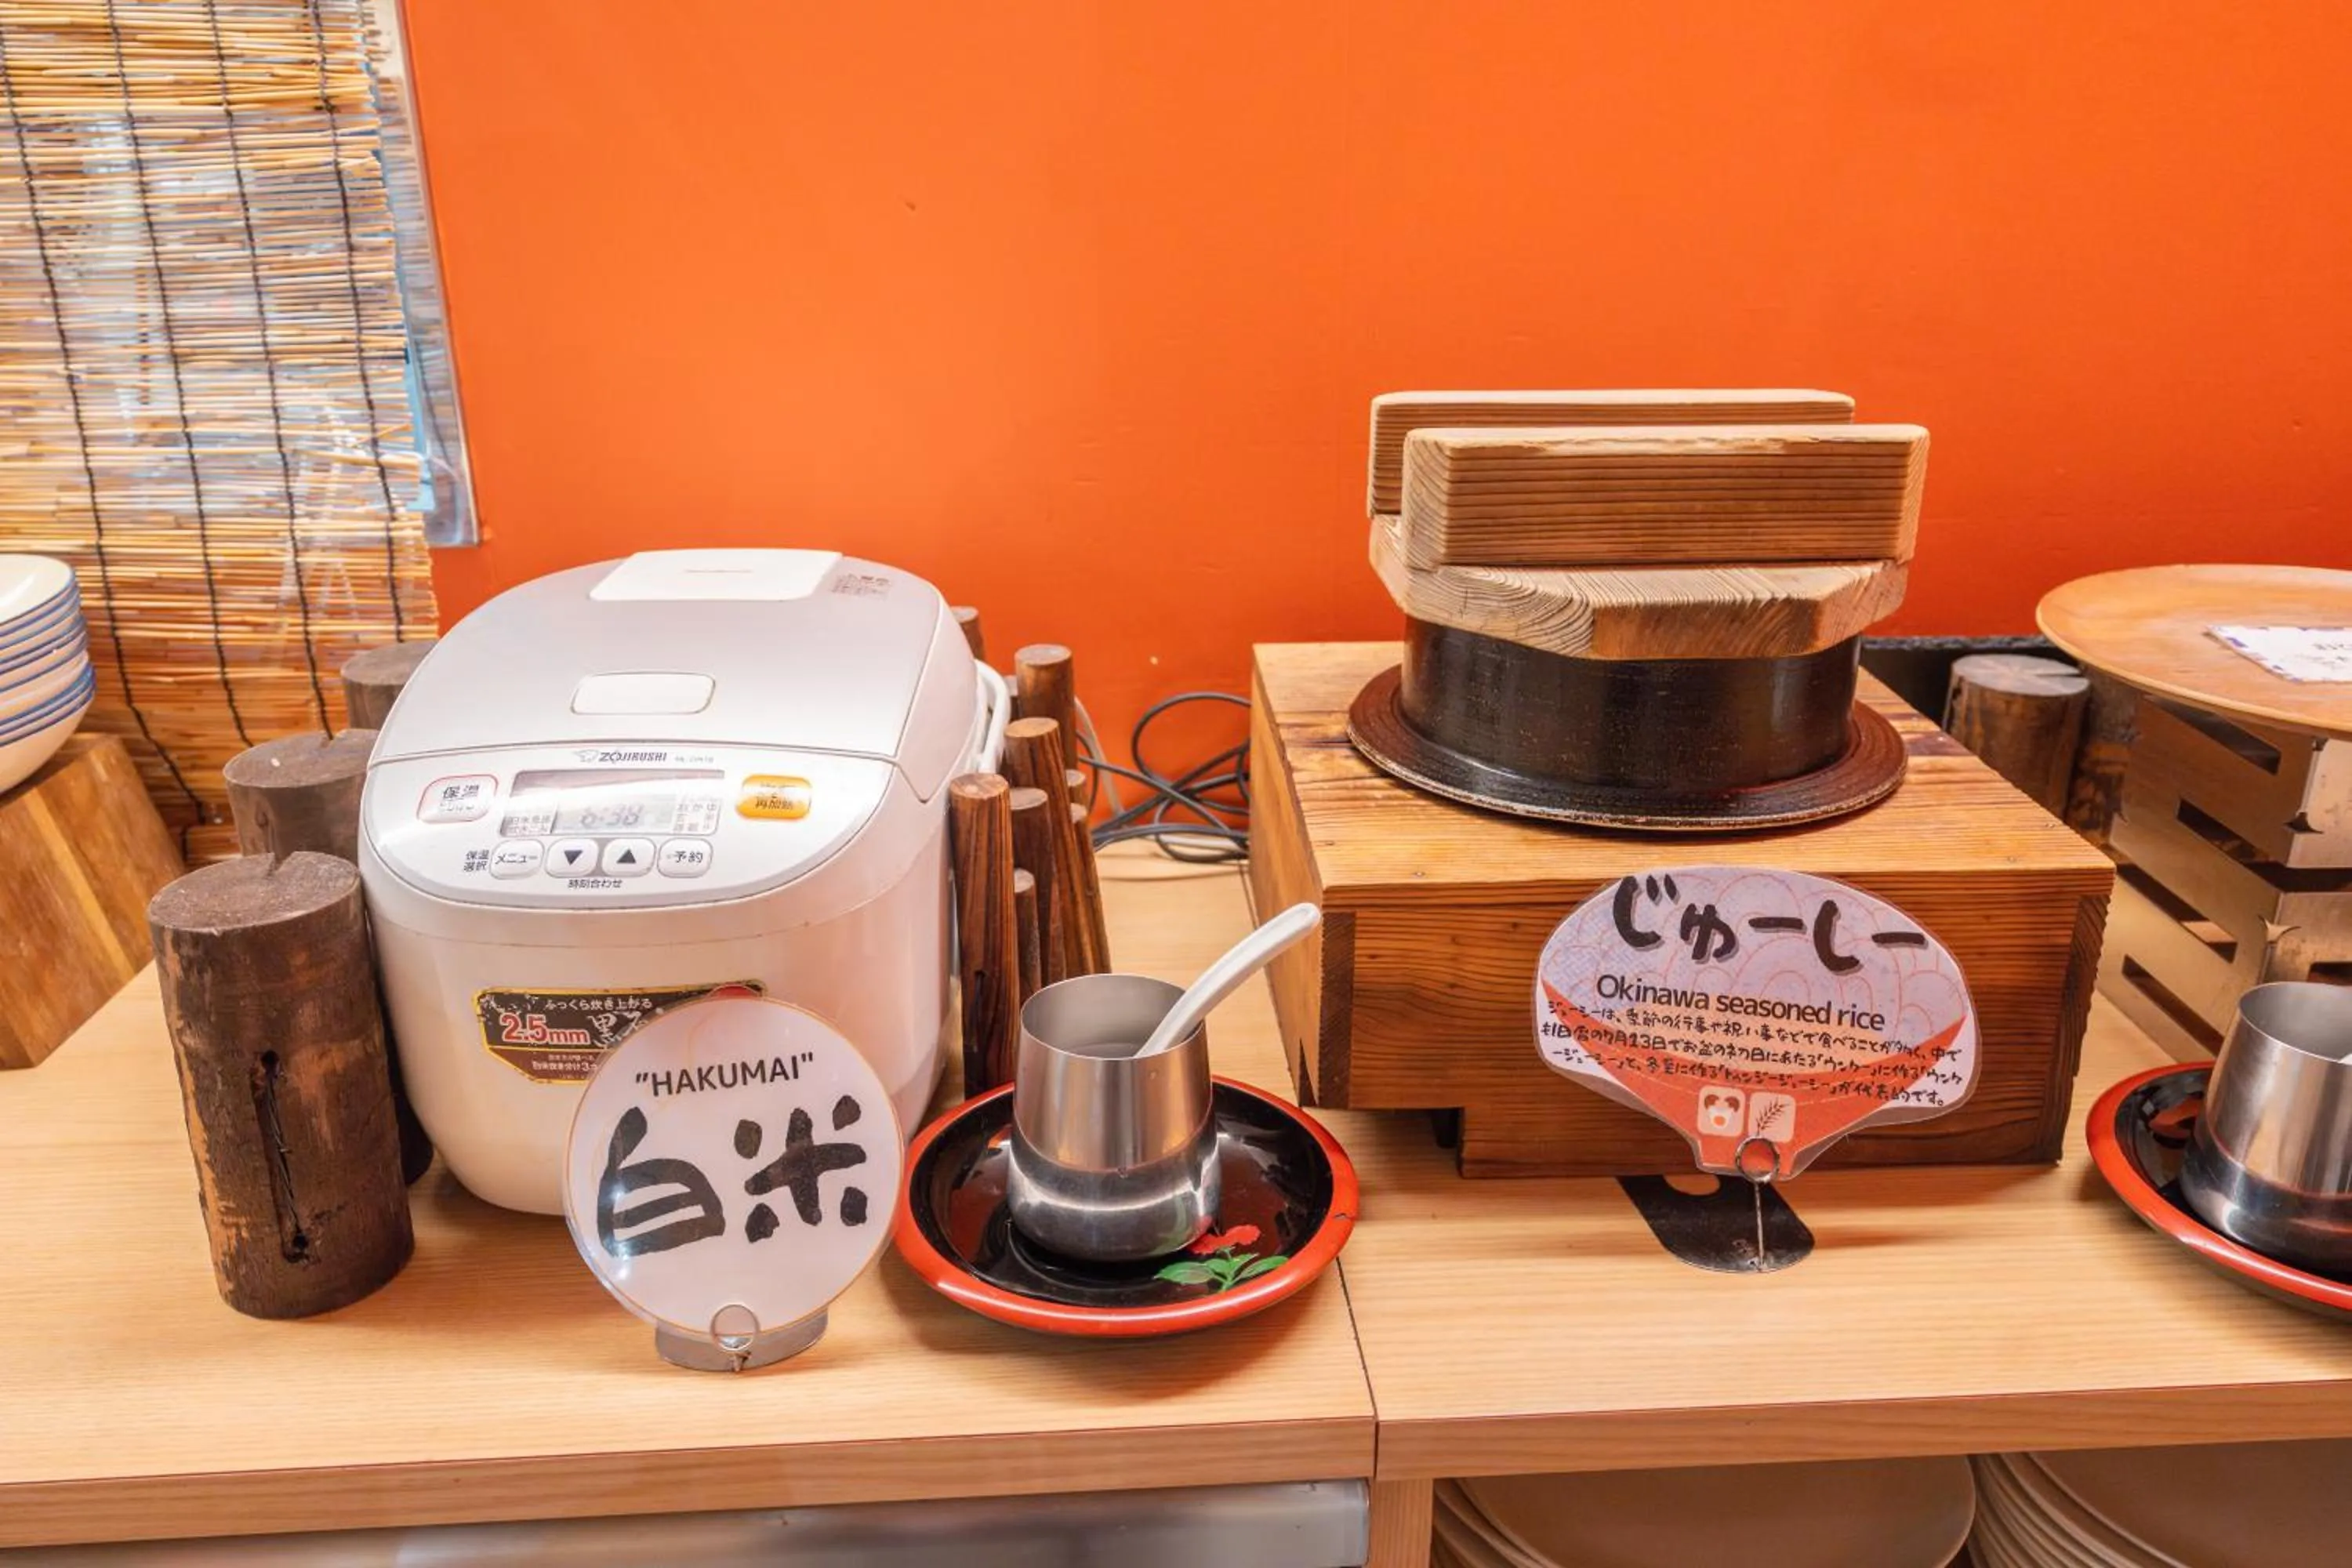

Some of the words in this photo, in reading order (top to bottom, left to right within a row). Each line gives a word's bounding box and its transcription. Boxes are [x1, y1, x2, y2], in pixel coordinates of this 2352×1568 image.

[597, 750, 667, 764] ZOJIRUSHI
[495, 853, 538, 864] メニュー
[673, 851, 703, 864] 予約
[568, 878, 623, 888] 時刻合わせ
[1595, 974, 1710, 1010] Okinawa
[1715, 991, 1832, 1025] seasoned
[1836, 1004, 1886, 1031] rice
[597, 1094, 867, 1257] 白米
